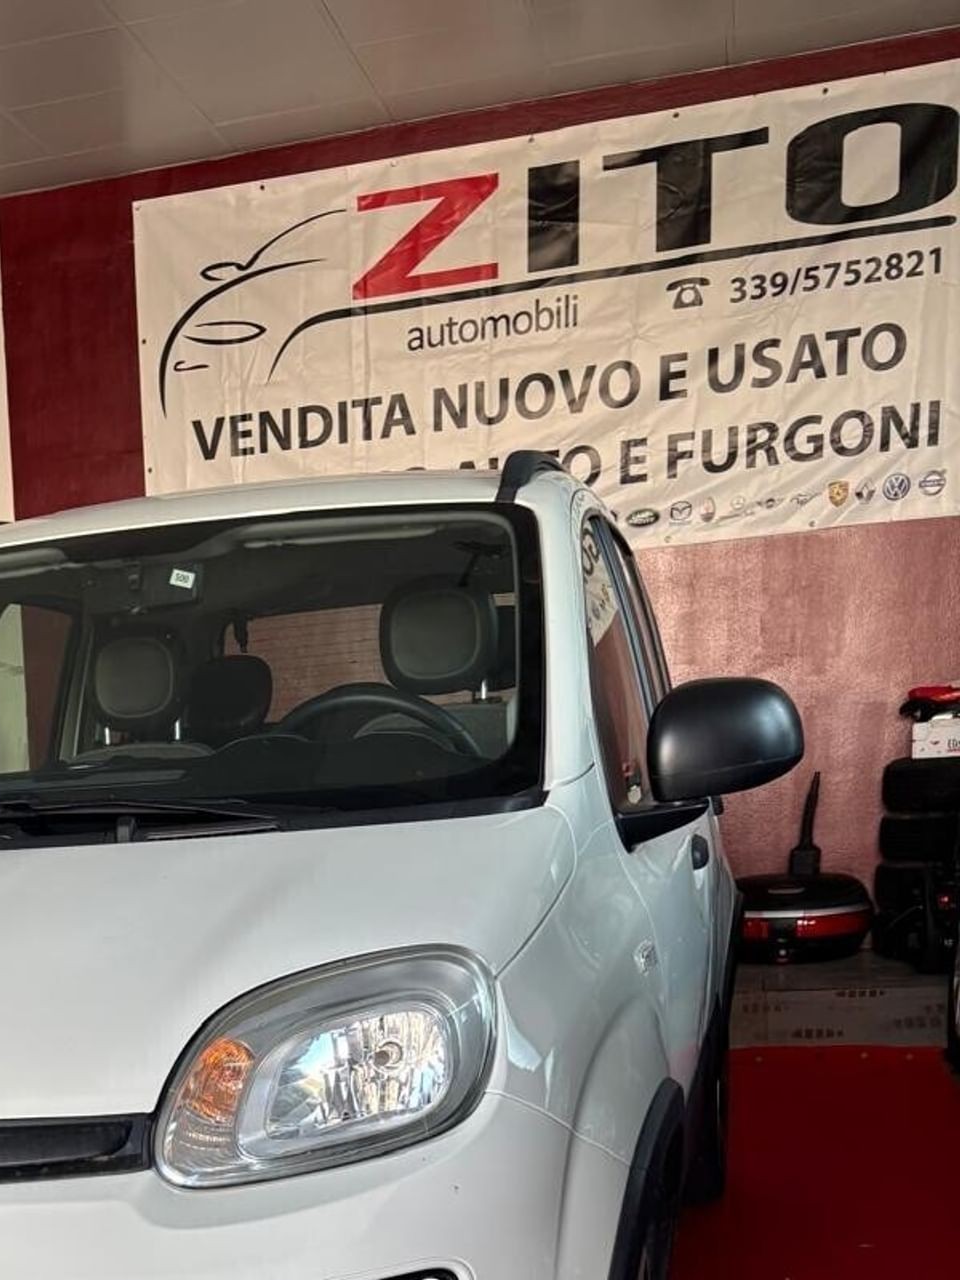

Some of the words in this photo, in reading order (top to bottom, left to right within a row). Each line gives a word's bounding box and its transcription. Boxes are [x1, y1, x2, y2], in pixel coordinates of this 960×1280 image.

[353, 102, 959, 300] ZITO
[729, 247, 943, 303] 339/5752821
[407, 295, 579, 351] automobili
[191, 393, 417, 460] VENDITA
[432, 359, 641, 432] NUOVO
[658, 352, 689, 401] E
[706, 322, 907, 394] USATO
[619, 438, 648, 485] E
[666, 400, 942, 479] FURGONI
